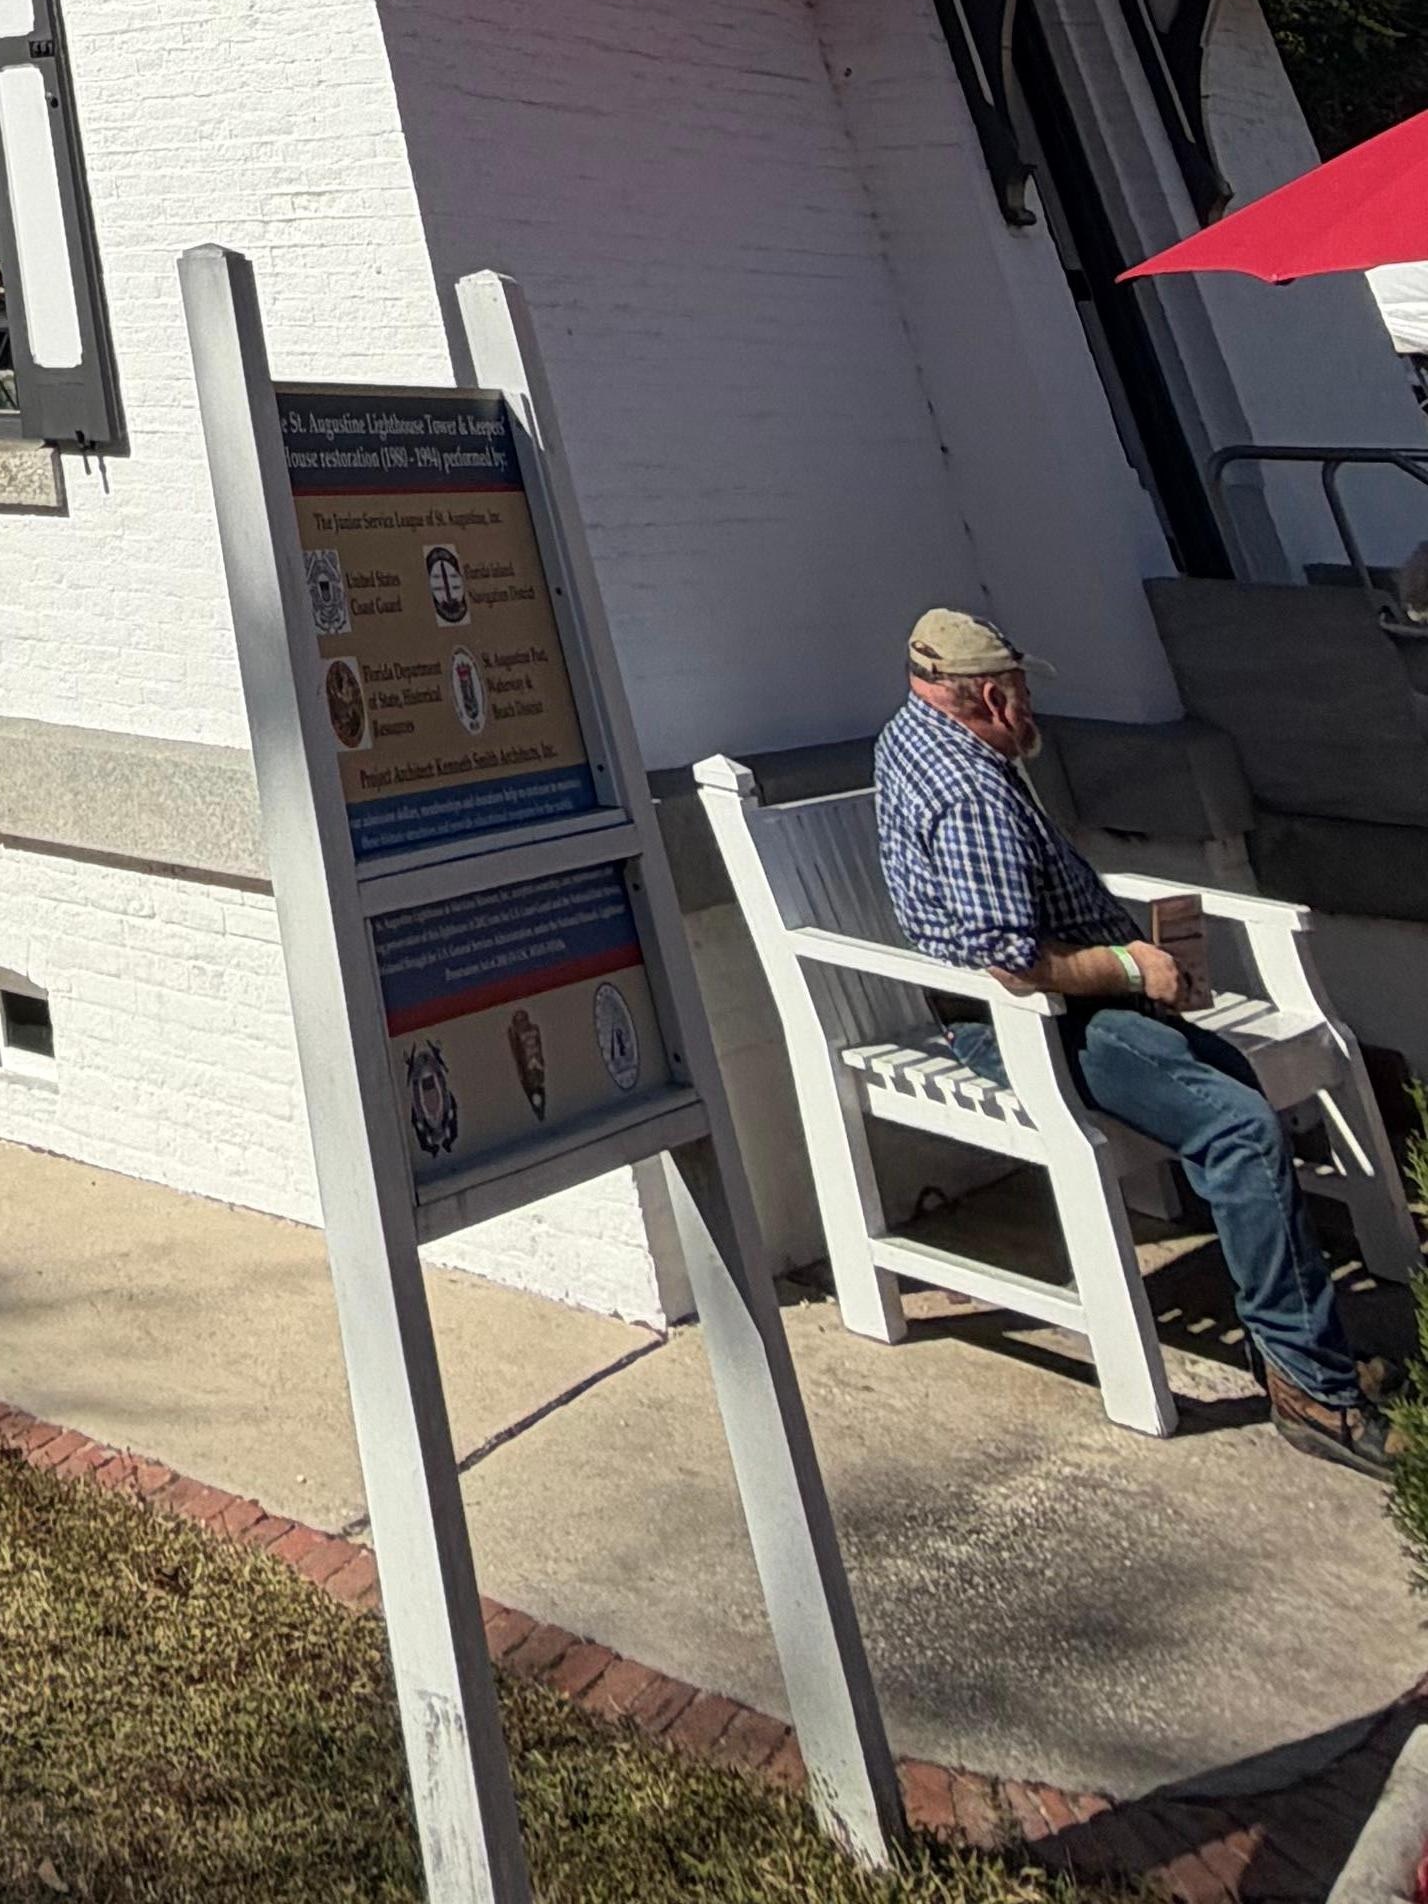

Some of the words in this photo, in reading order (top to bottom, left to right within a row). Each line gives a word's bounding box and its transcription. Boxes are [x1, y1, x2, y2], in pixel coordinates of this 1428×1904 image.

[289, 411, 306, 433] St.
[309, 411, 366, 441] Augustine
[366, 412, 424, 442] Lighthouse
[424, 414, 456, 435] Tower
[319, 446, 380, 468] restoration
[443, 445, 493, 474] performed
